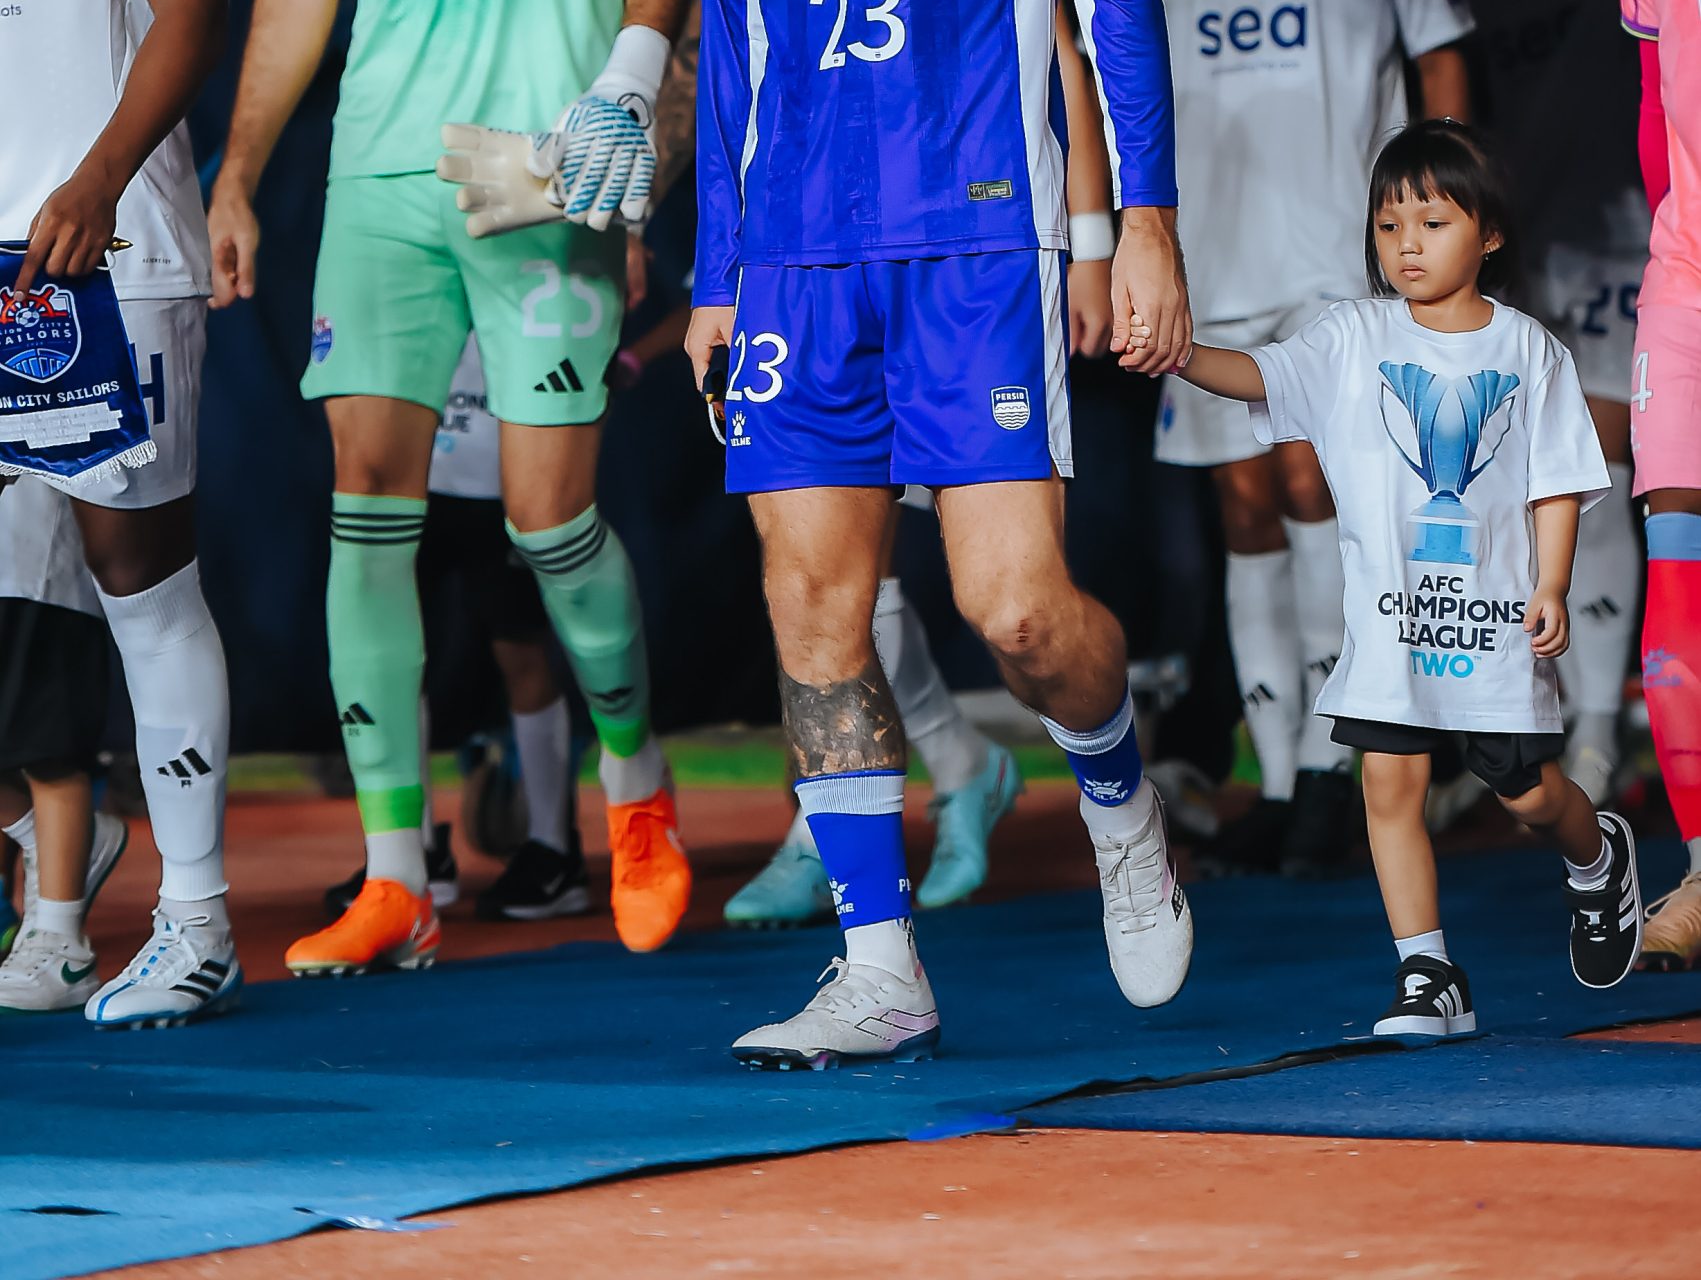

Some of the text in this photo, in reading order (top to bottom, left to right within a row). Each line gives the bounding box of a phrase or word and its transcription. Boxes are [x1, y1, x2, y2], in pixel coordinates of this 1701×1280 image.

[0, 3, 22, 17] ots
[1198, 6, 1306, 56] sea
[0, 328, 72, 345] AILORS
[725, 330, 789, 403] 23
[16, 393, 51, 407] CITY
[56, 380, 120, 403] SAILORS
[1417, 574, 1464, 594] AFC
[1377, 591, 1527, 624] CHAMPIONS
[1398, 620, 1497, 652] LEAGUE
